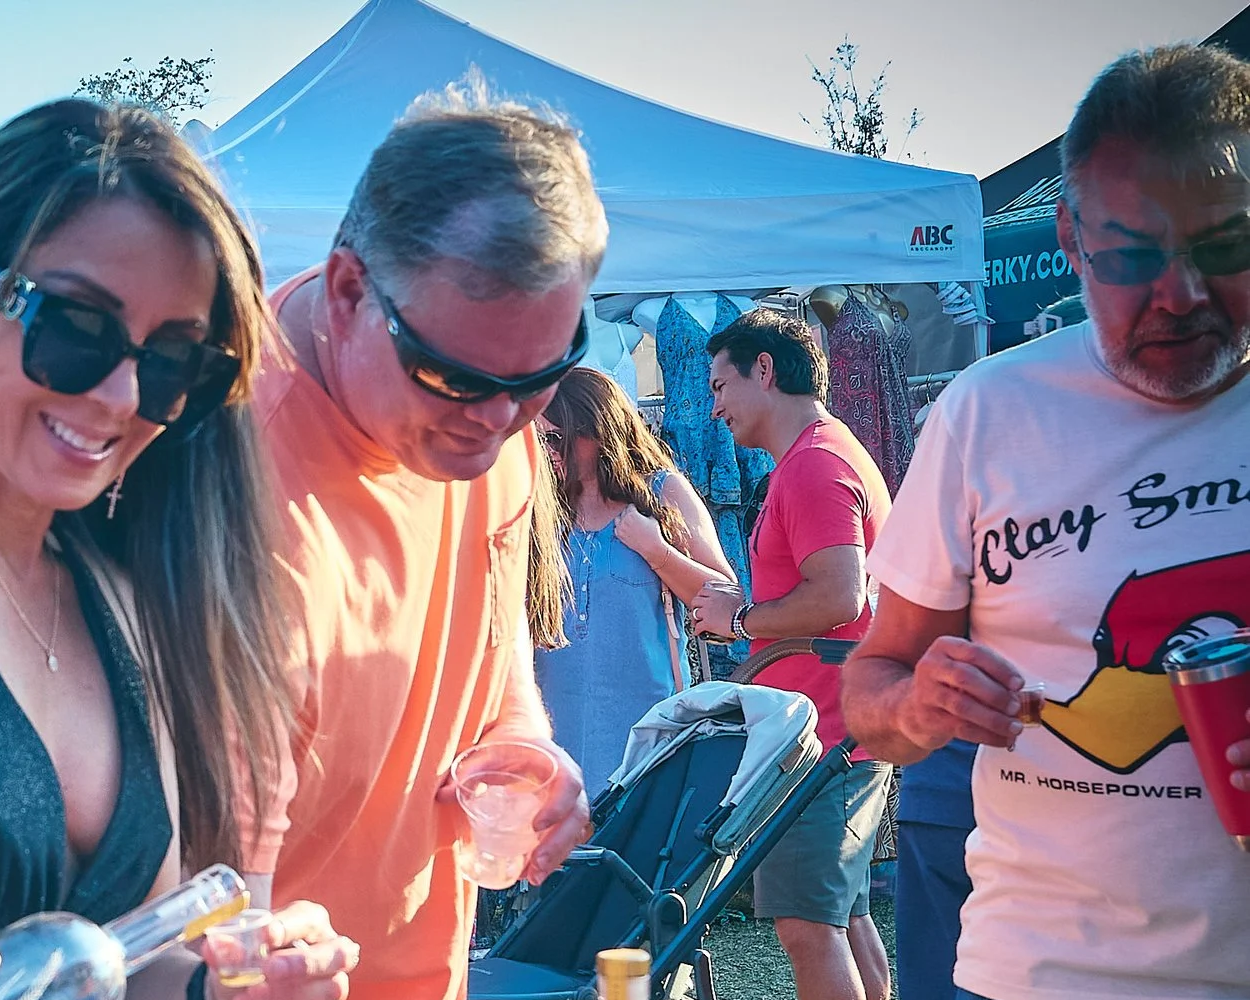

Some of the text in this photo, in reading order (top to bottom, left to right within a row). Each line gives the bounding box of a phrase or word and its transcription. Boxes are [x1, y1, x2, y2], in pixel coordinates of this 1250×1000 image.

[910, 225, 953, 246] ABC
[983, 248, 1074, 287] ERKY.CO
[979, 472, 1250, 587] Clay Sm
[1000, 769, 1202, 799] MR. HORSEPOWER
